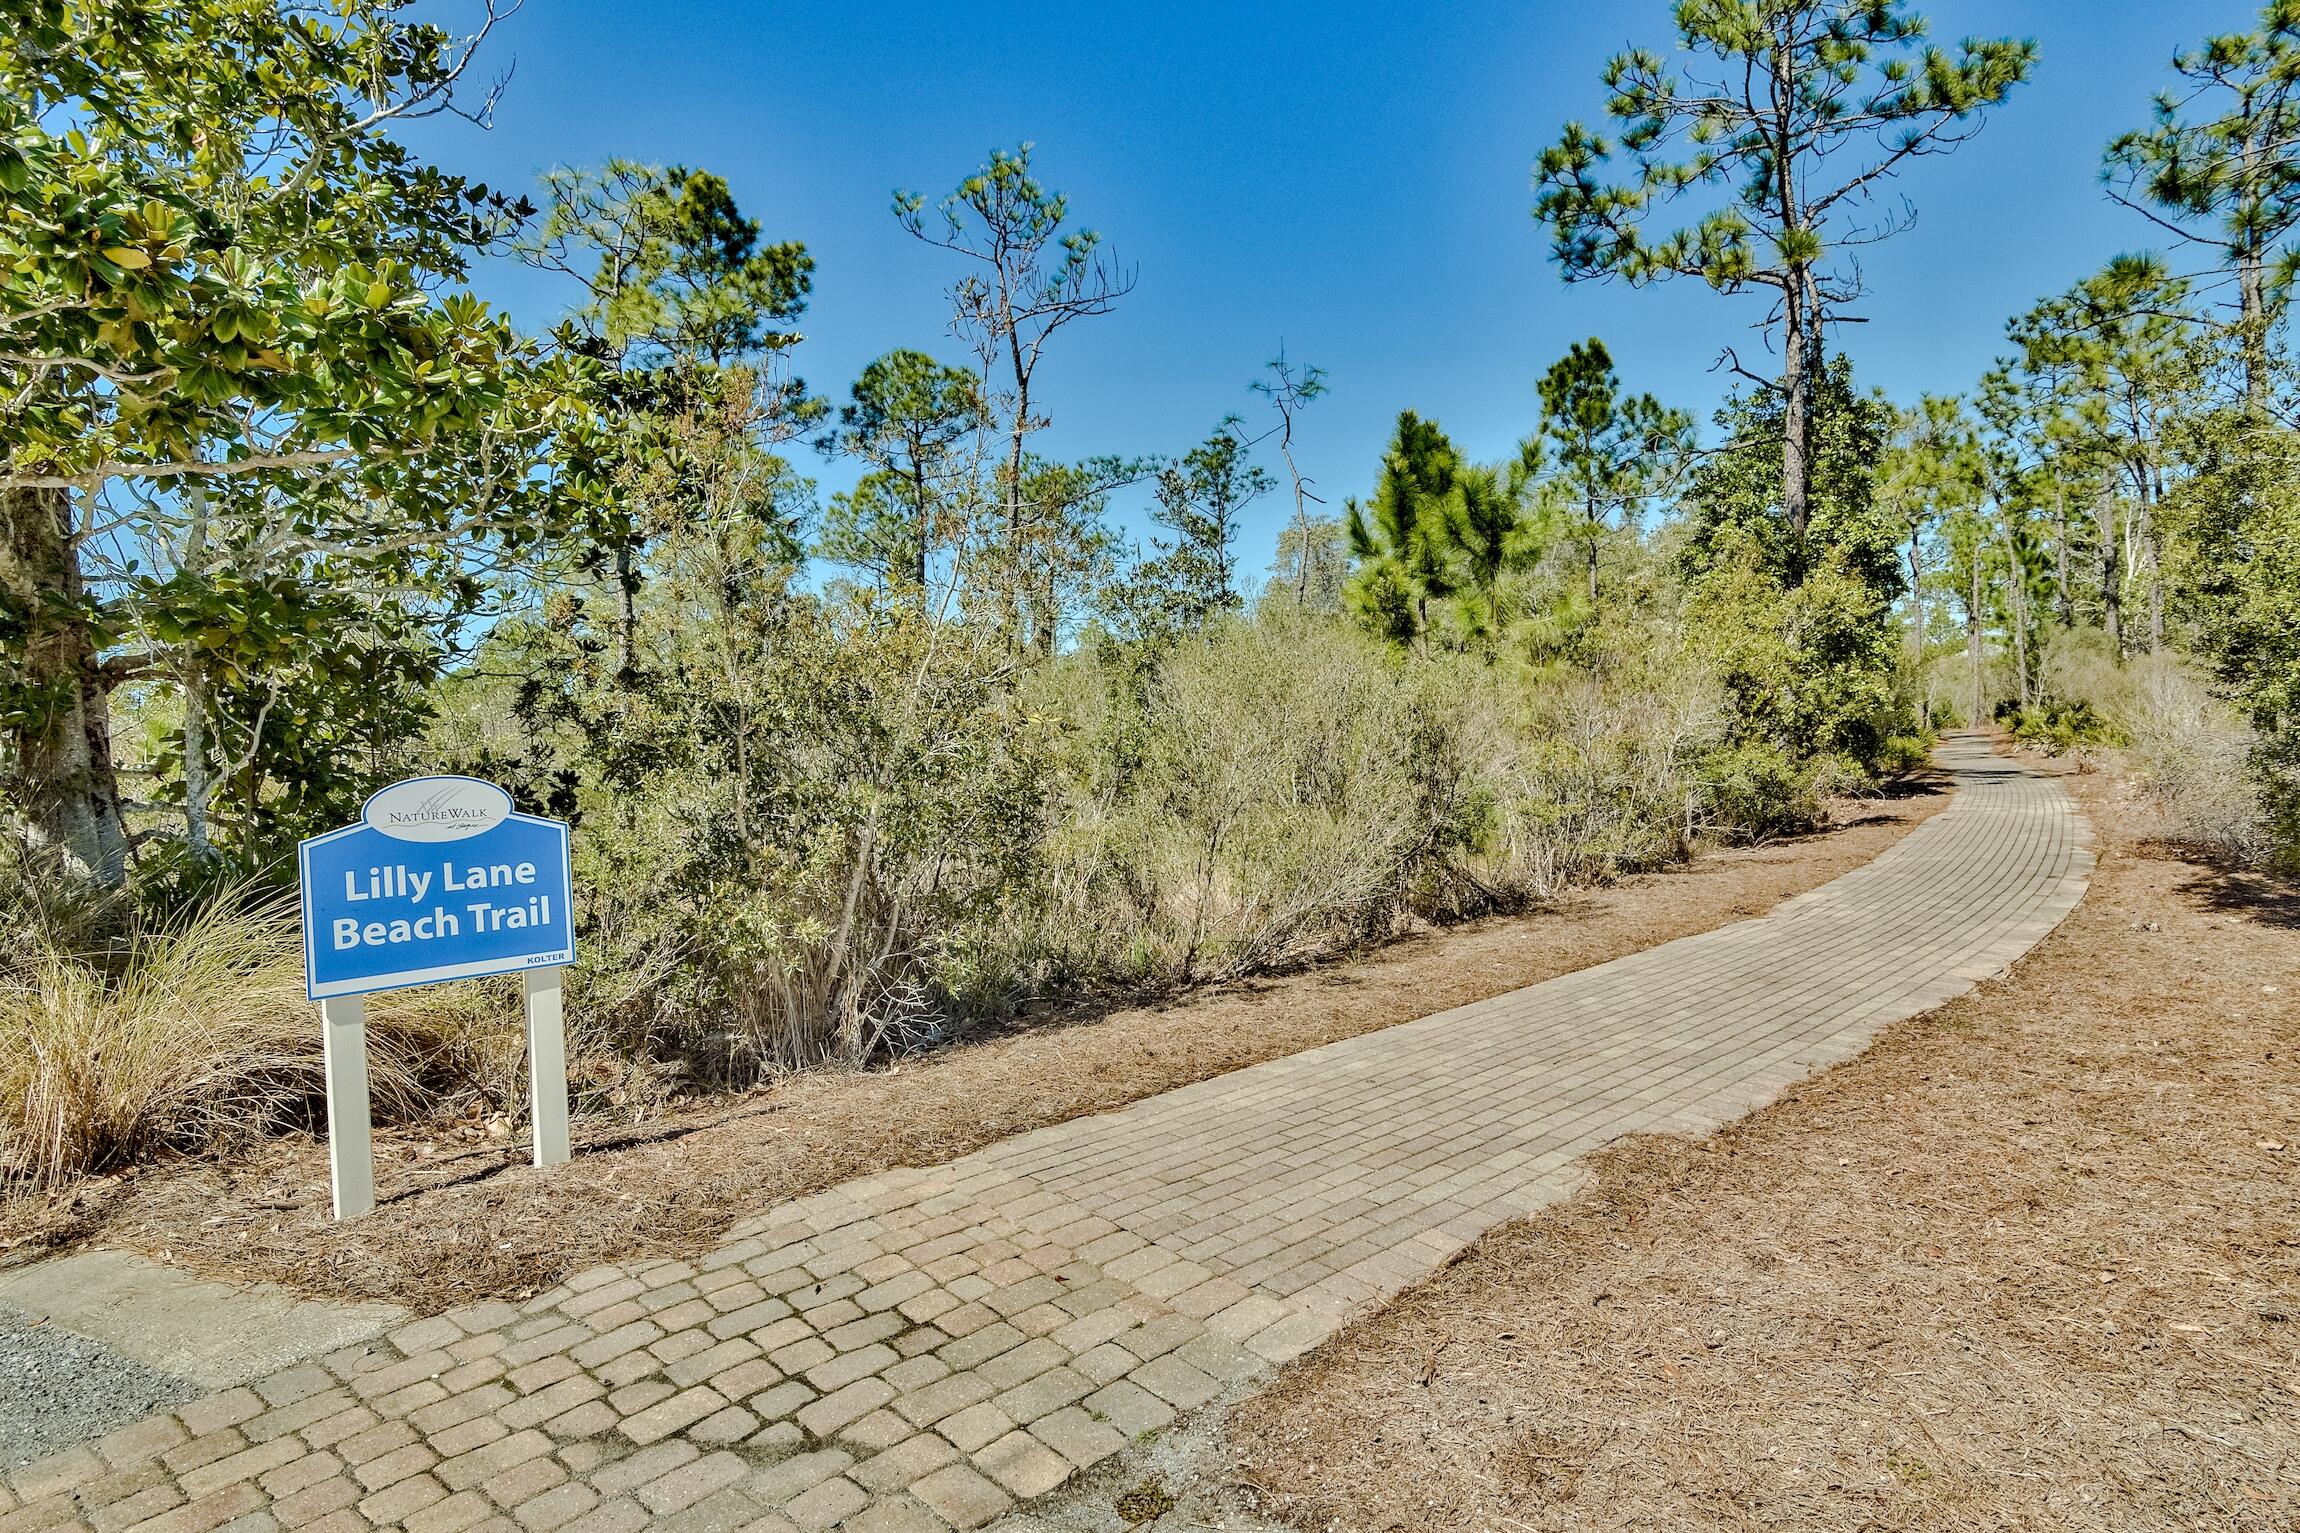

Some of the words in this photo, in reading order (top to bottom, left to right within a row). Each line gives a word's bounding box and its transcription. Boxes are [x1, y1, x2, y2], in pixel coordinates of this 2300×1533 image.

[345, 865, 432, 904] Lilly
[443, 861, 536, 891] Lane
[333, 906, 459, 950] Beach
[466, 895, 550, 933] Trail
[527, 953, 565, 964] KOLTER
